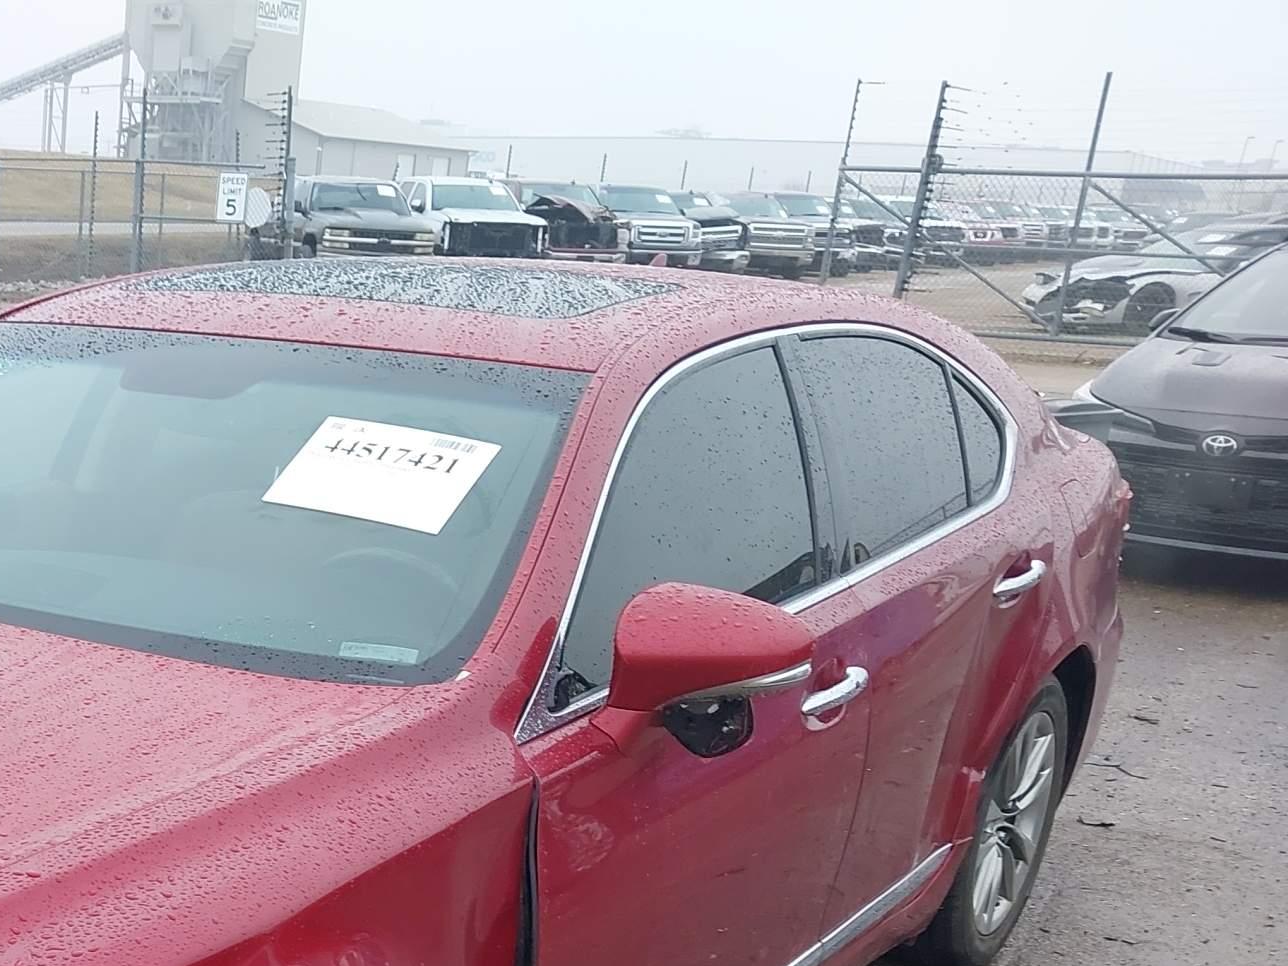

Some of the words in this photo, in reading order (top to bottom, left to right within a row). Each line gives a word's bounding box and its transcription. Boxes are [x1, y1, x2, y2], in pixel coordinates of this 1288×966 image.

[257, 0, 299, 21] ROANOKE
[222, 176, 246, 186] SPEED
[222, 187, 244, 197] LIMIT
[224, 198, 237, 217] 5
[324, 438, 459, 473] 44517421
